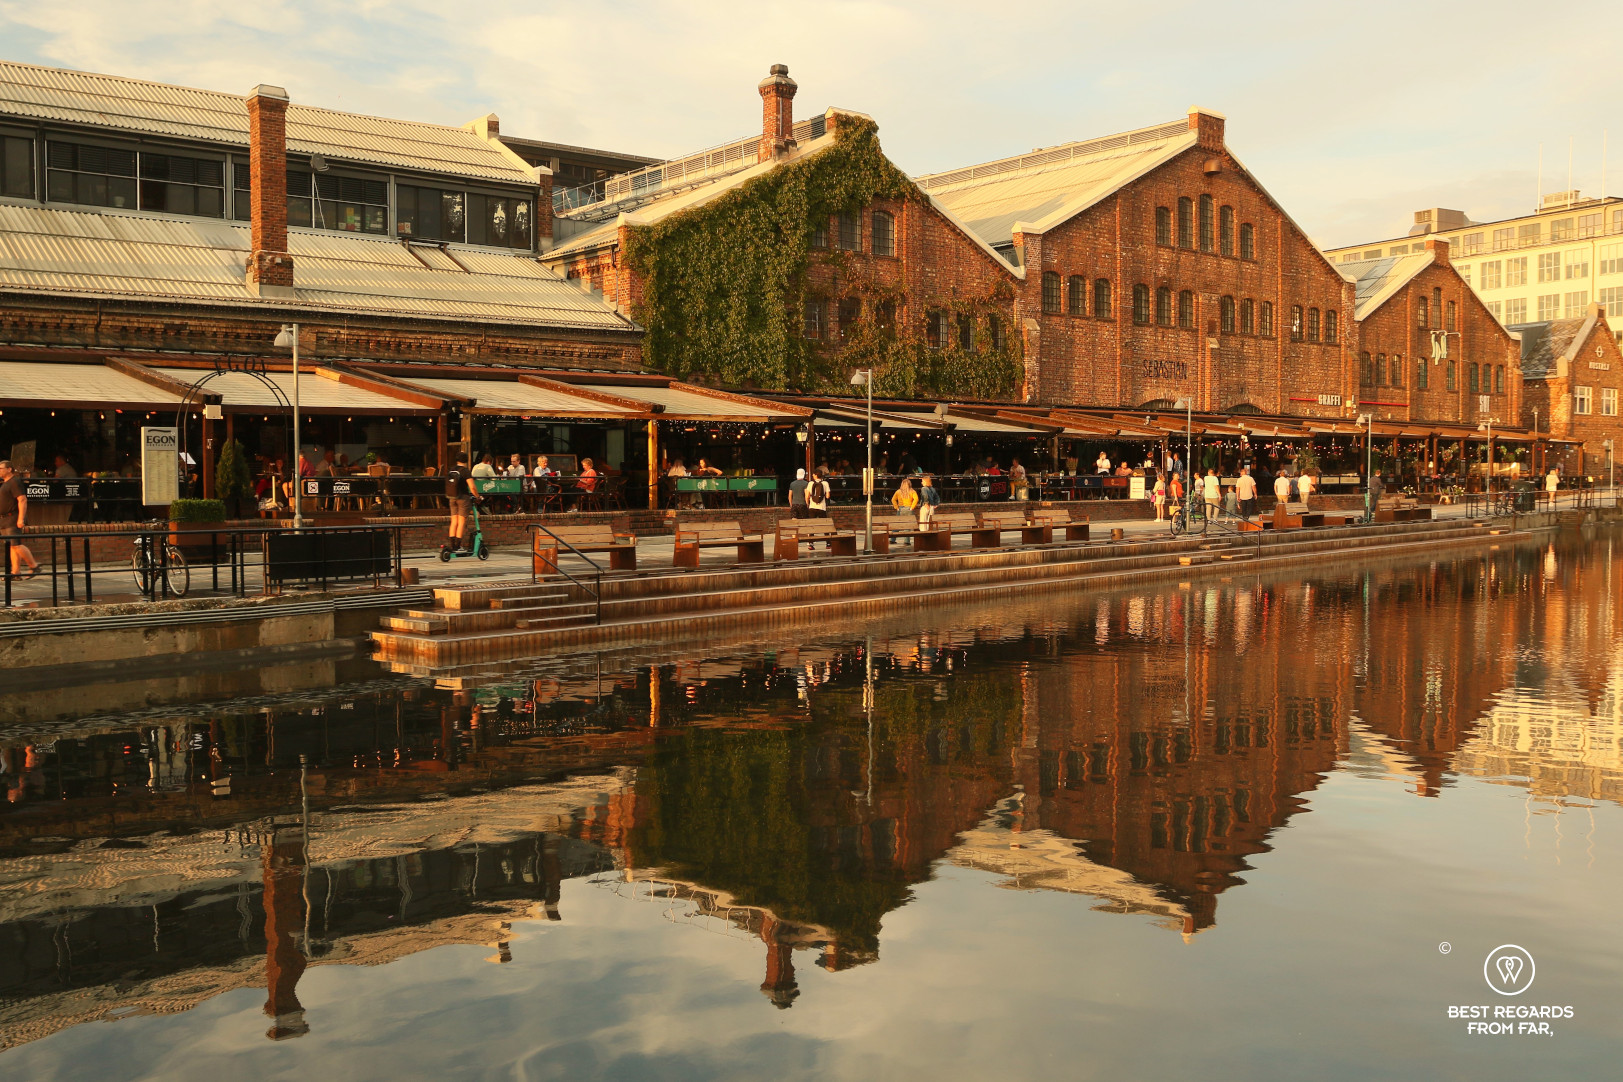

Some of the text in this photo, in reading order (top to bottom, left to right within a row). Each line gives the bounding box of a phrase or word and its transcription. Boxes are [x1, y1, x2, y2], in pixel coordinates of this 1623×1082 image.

[1143, 359, 1188, 380] SEBASTIAN
[1318, 394, 1341, 406] GRAFFI
[146, 435, 176, 444] EGON
[27, 487, 50, 495] EGON
